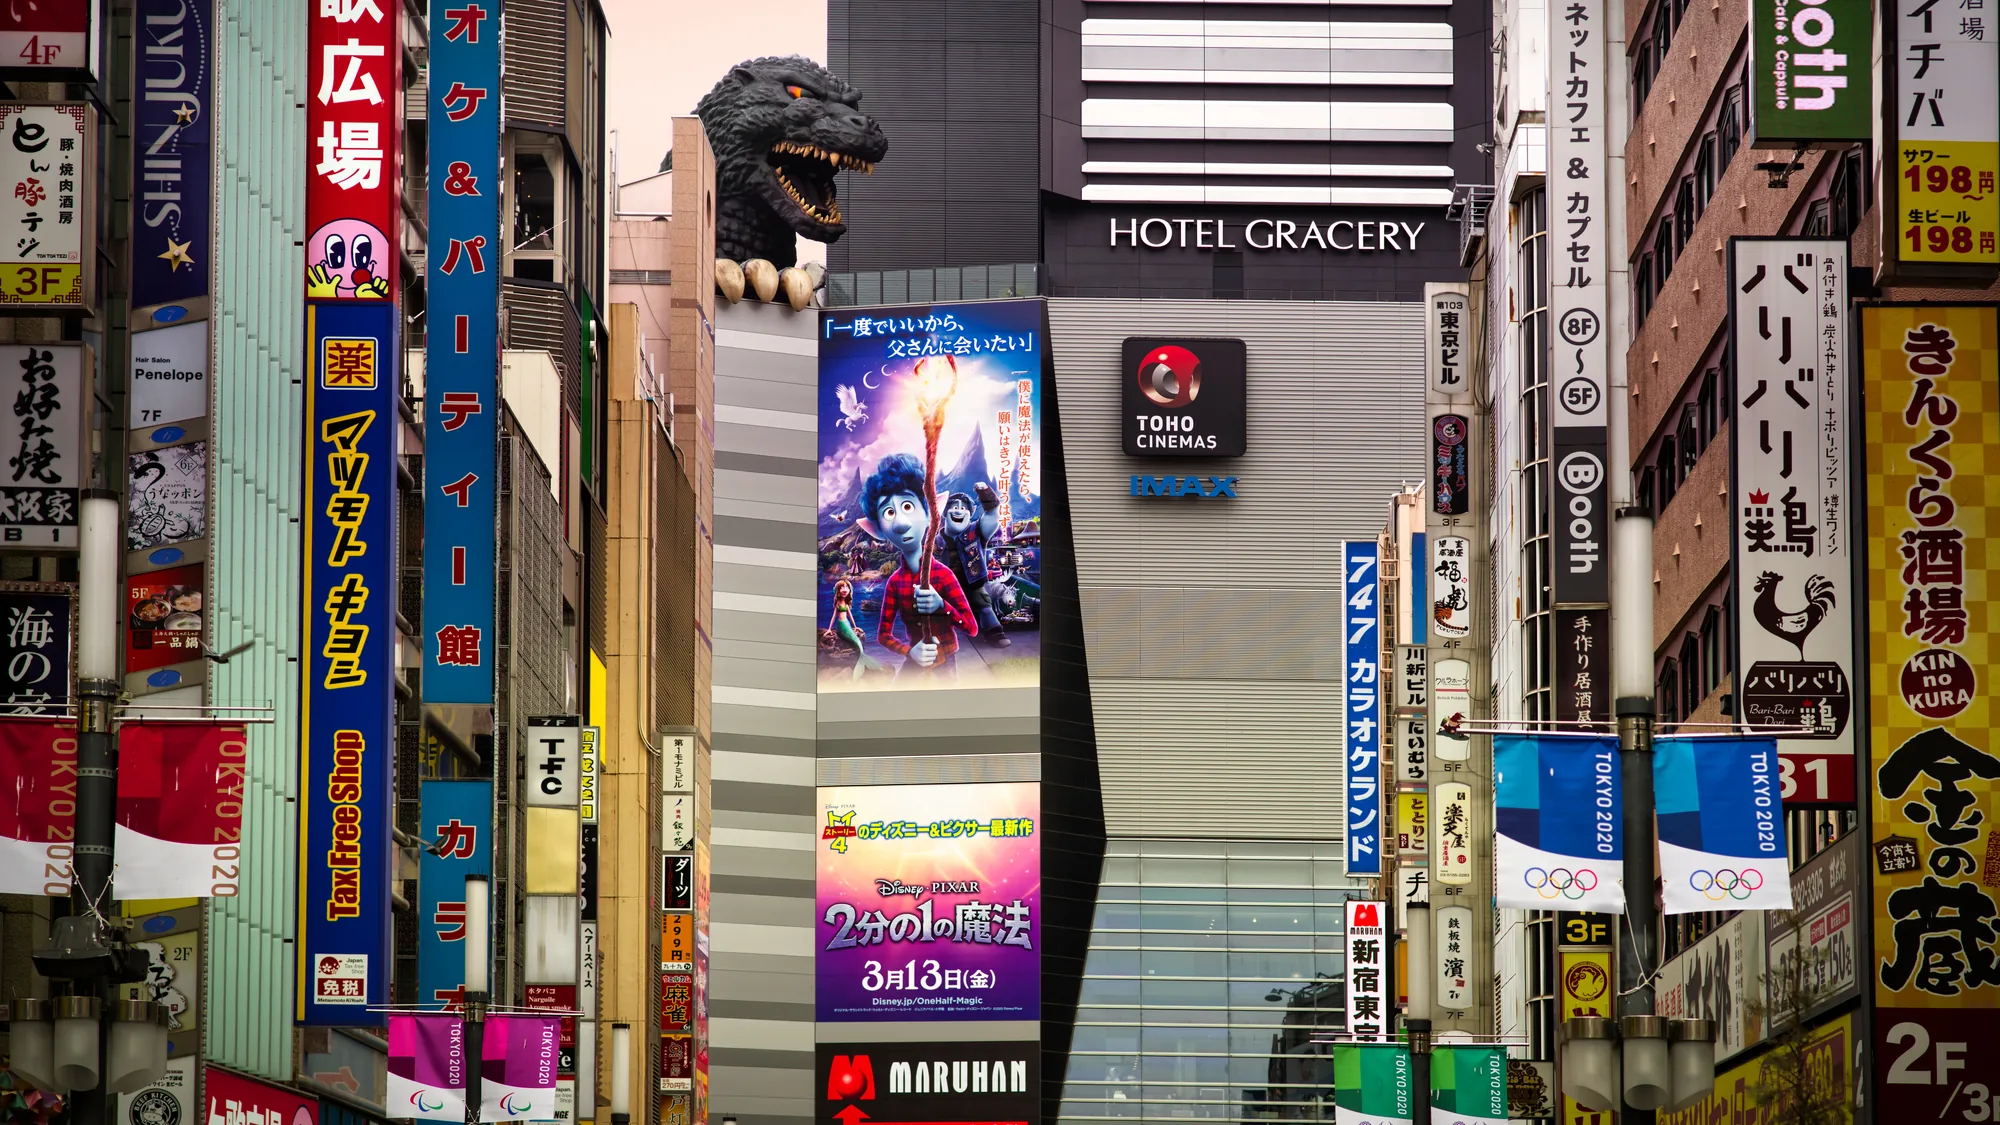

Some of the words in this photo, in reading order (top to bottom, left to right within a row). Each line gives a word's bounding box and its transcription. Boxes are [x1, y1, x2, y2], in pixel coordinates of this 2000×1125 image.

[20, 35, 61, 65] 4F
[1773, 50, 1790, 110] Capsule
[1903, 150, 1950, 164] サワー
[59, 138, 74, 224] 豚・焼肉酒房
[1904, 165, 1973, 194] 198
[1908, 209, 1971, 224] 生ビール
[1110, 217, 1236, 249] HOTEL
[1245, 218, 1425, 251] GRACERY
[1566, 192, 1592, 289] カプセル
[1905, 225, 1974, 254] 198
[15, 267, 62, 295] 3F
[826, 314, 965, 338] 「一度でいいから、
[1567, 318, 1592, 336] 8F
[887, 332, 1032, 359] 父さんに会いたい」
[1440, 311, 1460, 385] 東京ビル
[135, 369, 203, 382] Penelope
[327, 341, 373, 385] 薬
[1823, 324, 1837, 401] 炭火やきとり
[1567, 387, 1593, 405] 5F
[10, 347, 62, 484] お好み焼
[141, 410, 162, 421] 7F
[1136, 415, 1194, 432] TOHO
[1136, 434, 1217, 449] CINEMAS
[1129, 474, 1240, 499] IMAX
[1903, 323, 1968, 646] きんくら酒場
[1442, 518, 1460, 527] 3F
[1558, 451, 1604, 574] Booth
[132, 588, 149, 599] 5F
[154, 637, 199, 649] 一品鍋
[1443, 641, 1461, 649] 4F
[1911, 653, 1956, 673] KIN
[1748, 669, 1842, 694] バリバリ
[1923, 675, 1953, 688] no
[1750, 703, 1796, 715] Bari-Bari
[1909, 689, 1971, 711] KURA
[1349, 658, 1377, 862] カラオケランド
[1408, 721, 1425, 779] にいむら
[49, 723, 77, 817] TOKYO
[215, 726, 247, 818] TOKYO
[328, 729, 365, 803] Shop
[540, 738, 565, 795] TFC
[1444, 764, 1462, 772] 5F
[1595, 752, 1613, 808] TOKYO
[1750, 751, 1772, 807] TOKYO
[825, 828, 855, 836] ストーリー
[857, 819, 1034, 840] のディズニー&ピクサー最新作
[1596, 811, 1613, 853] 2020
[1755, 810, 1776, 852] 2020
[830, 836, 848, 854] 4
[44, 825, 75, 897] 2020
[211, 826, 241, 897] 2020
[1884, 856, 1916, 871] 立寄り
[675, 857, 690, 898] ダーツ
[931, 882, 980, 893] PIXAR
[1445, 887, 1463, 896] 6F
[671, 914, 682, 960] 299円
[823, 898, 1033, 951] 2分の1の魔法
[1350, 927, 1383, 936] MARUHAN
[1448, 917, 1460, 953] 鉄板焼
[1566, 919, 1607, 943] 3F
[174, 947, 193, 961] 2F
[584, 927, 593, 988] ヘアースペース
[323, 979, 359, 995] 免税
[861, 959, 996, 991] 3月13日(金)
[662, 984, 691, 1024] 麻雀
[872, 997, 983, 1007] Disney.jp/OneHalf-Magic
[1447, 1011, 1464, 1020] 7F
[450, 1022, 461, 1057] TOKYO
[541, 1024, 554, 1058] TOKYO
[1886, 1021, 1968, 1085] 2F
[449, 1058, 460, 1085] 2020
[538, 1059, 551, 1085] 2020
[889, 1060, 1027, 1094] MARUHAN
[1395, 1054, 1406, 1088] TOKYO
[1490, 1054, 1500, 1088] TOKYO
[1396, 1089, 1407, 1115] 2020
[1490, 1089, 1502, 1115] 2020
